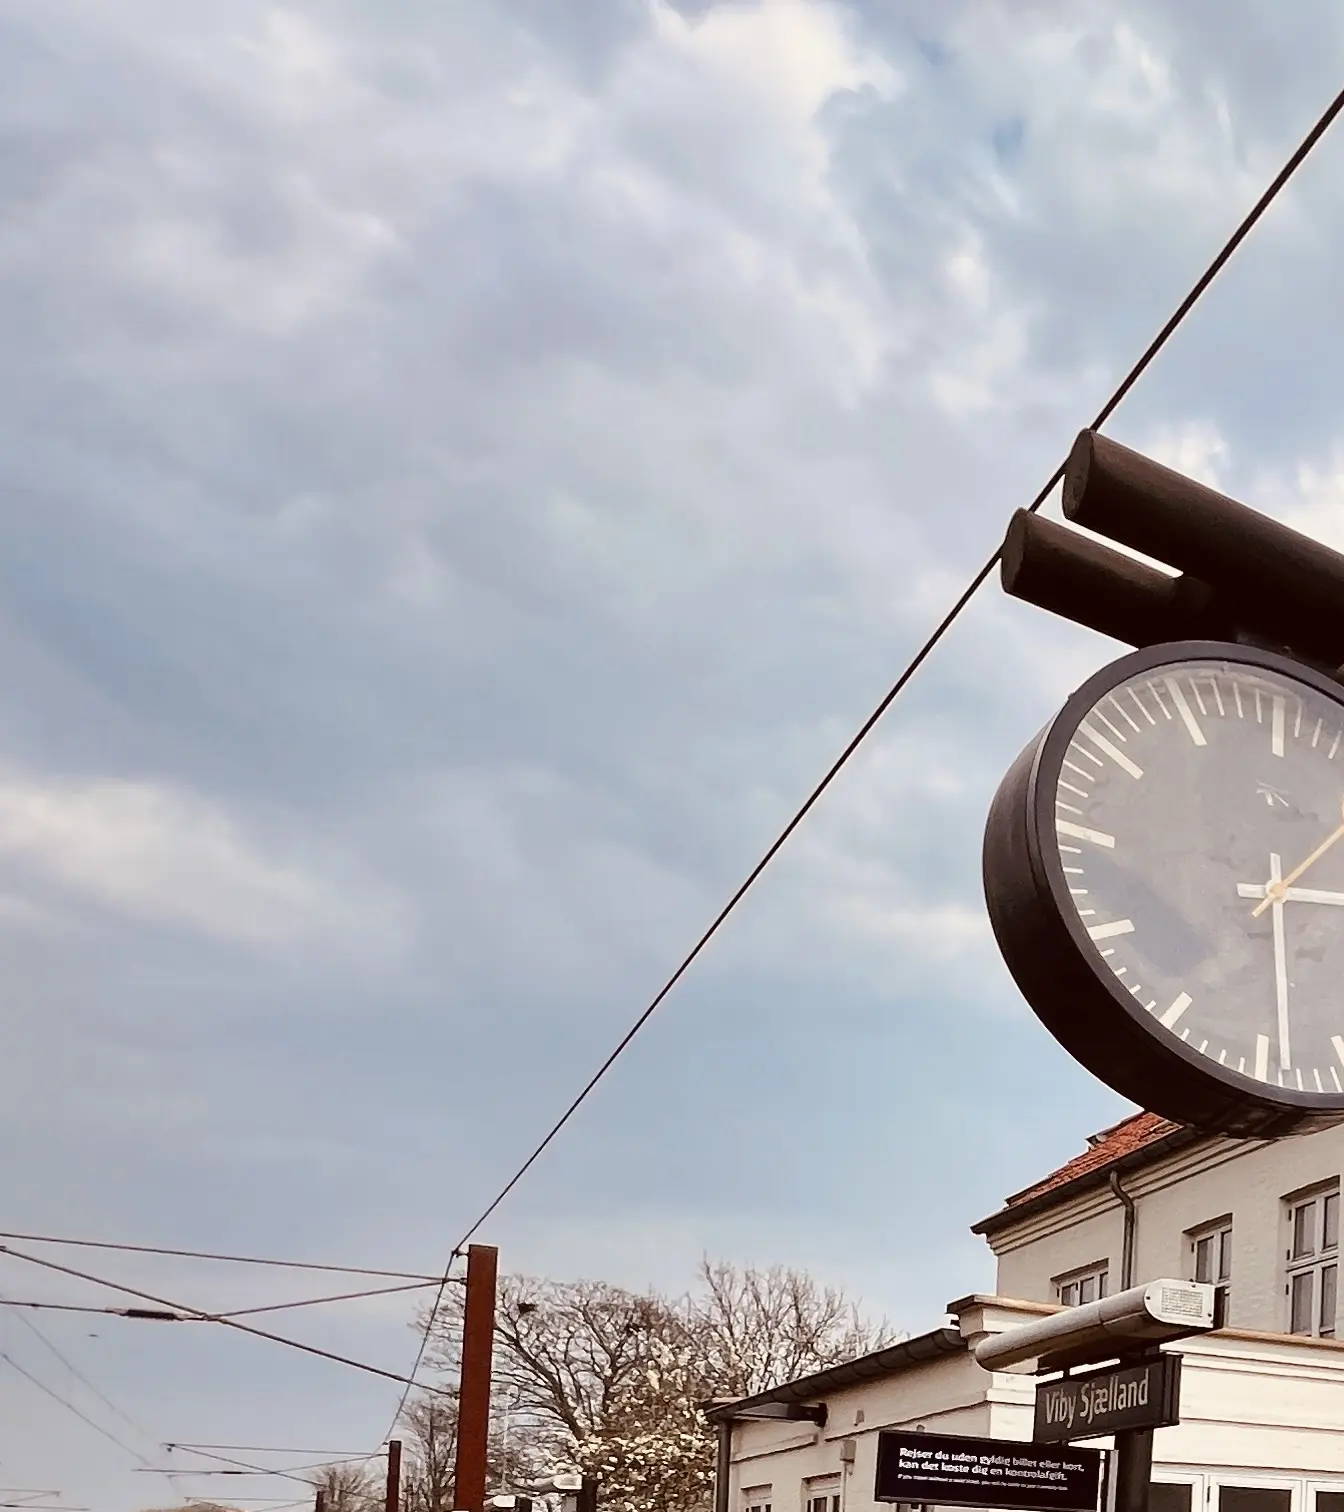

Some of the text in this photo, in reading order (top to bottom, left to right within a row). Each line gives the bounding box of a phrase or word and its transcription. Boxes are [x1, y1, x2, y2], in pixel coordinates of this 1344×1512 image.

[1046, 1368, 1149, 1429] Viby Sjælland
[900, 1447, 933, 1459] Rejser
[935, 1450, 949, 1460] du
[952, 1453, 978, 1462] uden
[899, 1458, 919, 1469] kan
[921, 1461, 939, 1471] det
[942, 1462, 970, 1473] koste
[972, 1465, 989, 1475] dig
